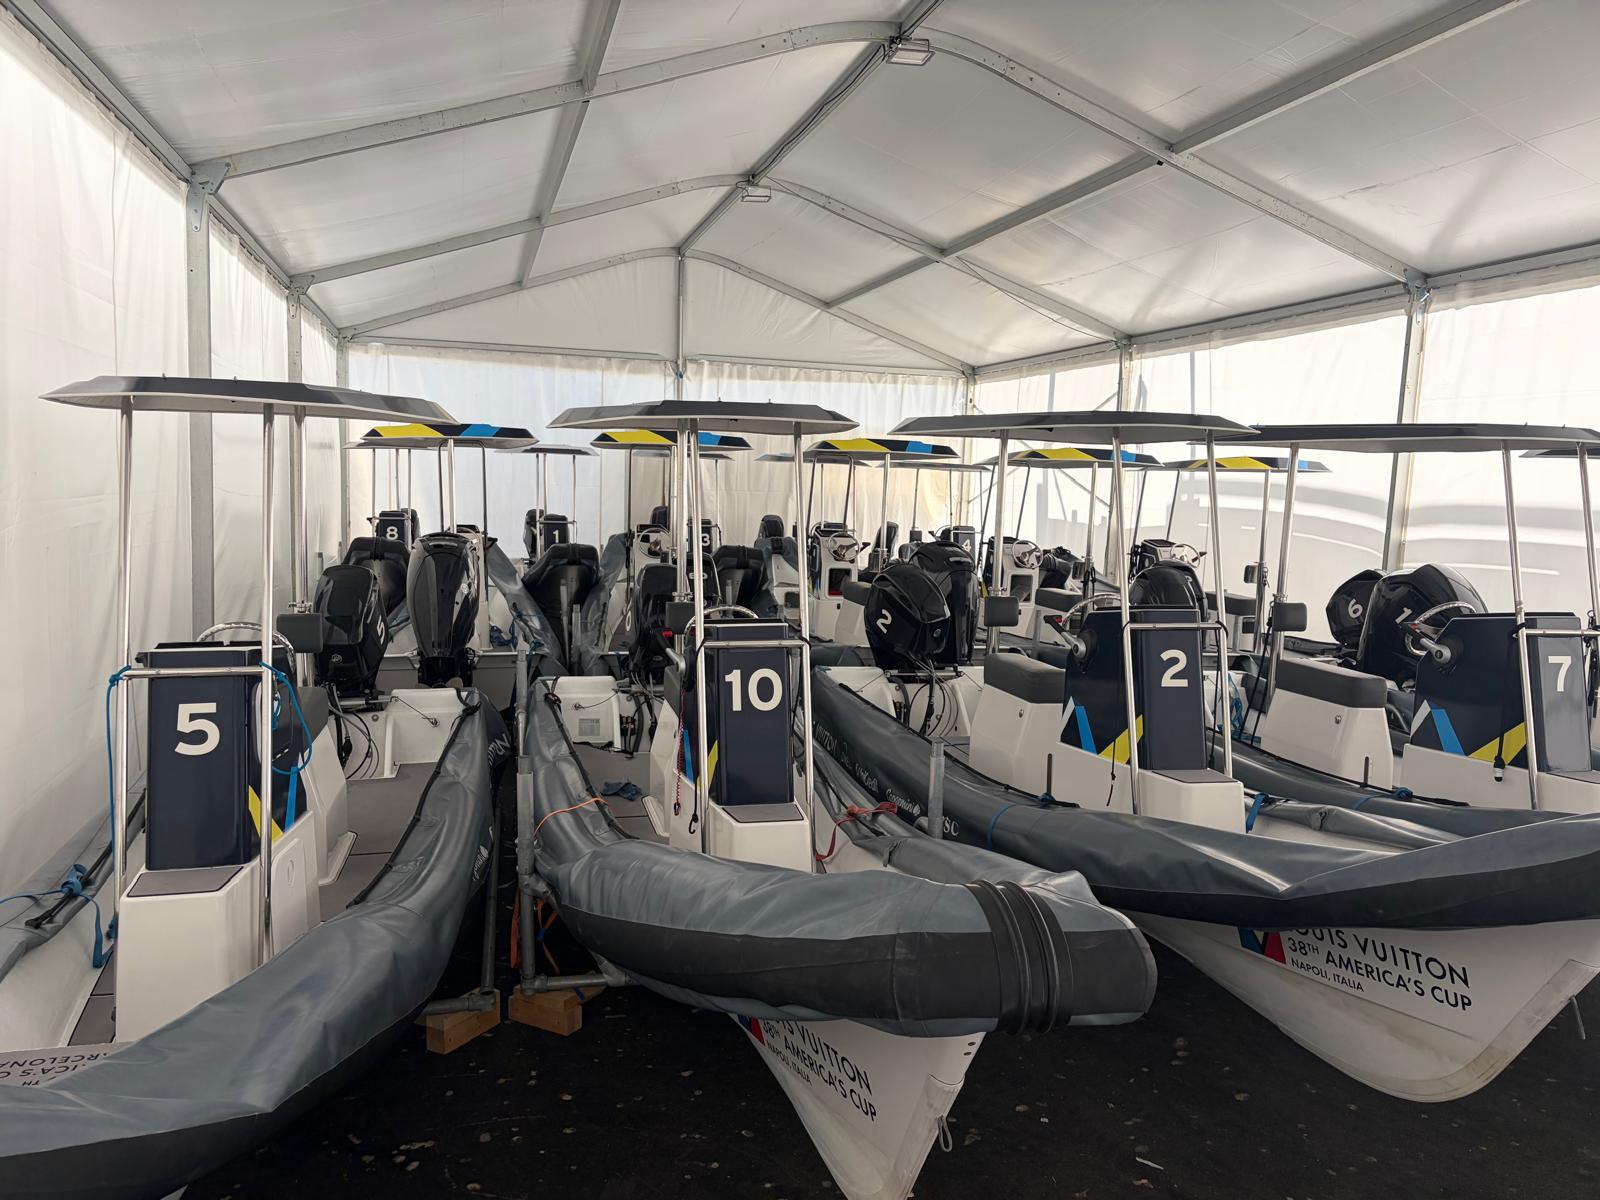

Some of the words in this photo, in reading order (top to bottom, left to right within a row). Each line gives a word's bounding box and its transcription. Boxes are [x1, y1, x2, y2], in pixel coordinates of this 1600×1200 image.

[386, 526, 398, 540] 8
[552, 529, 559, 543] 1
[962, 539, 972, 553] 4
[876, 609, 892, 634] 2
[1348, 599, 1363, 619] 6
[376, 615, 385, 645] 5
[1160, 649, 1188, 688] 2
[1547, 655, 1572, 692] 7
[724, 668, 783, 712] 10
[174, 702, 221, 756] 5
[942, 815, 960, 836] SC
[1287, 936, 1319, 956] 38TH
[1325, 949, 1425, 997] AMERICA'S
[1431, 985, 1472, 1011] CUP
[1291, 957, 1331, 980] NAPOLI,
[1333, 973, 1364, 992] ITALIA
[1352, 934, 1470, 989] VUITTON
[20, 1063, 86, 1077] ICA'S
[794, 1020, 873, 1097] VUITTON
[784, 1035, 847, 1099] AMERICA'S
[850, 1090, 877, 1122] CUP
